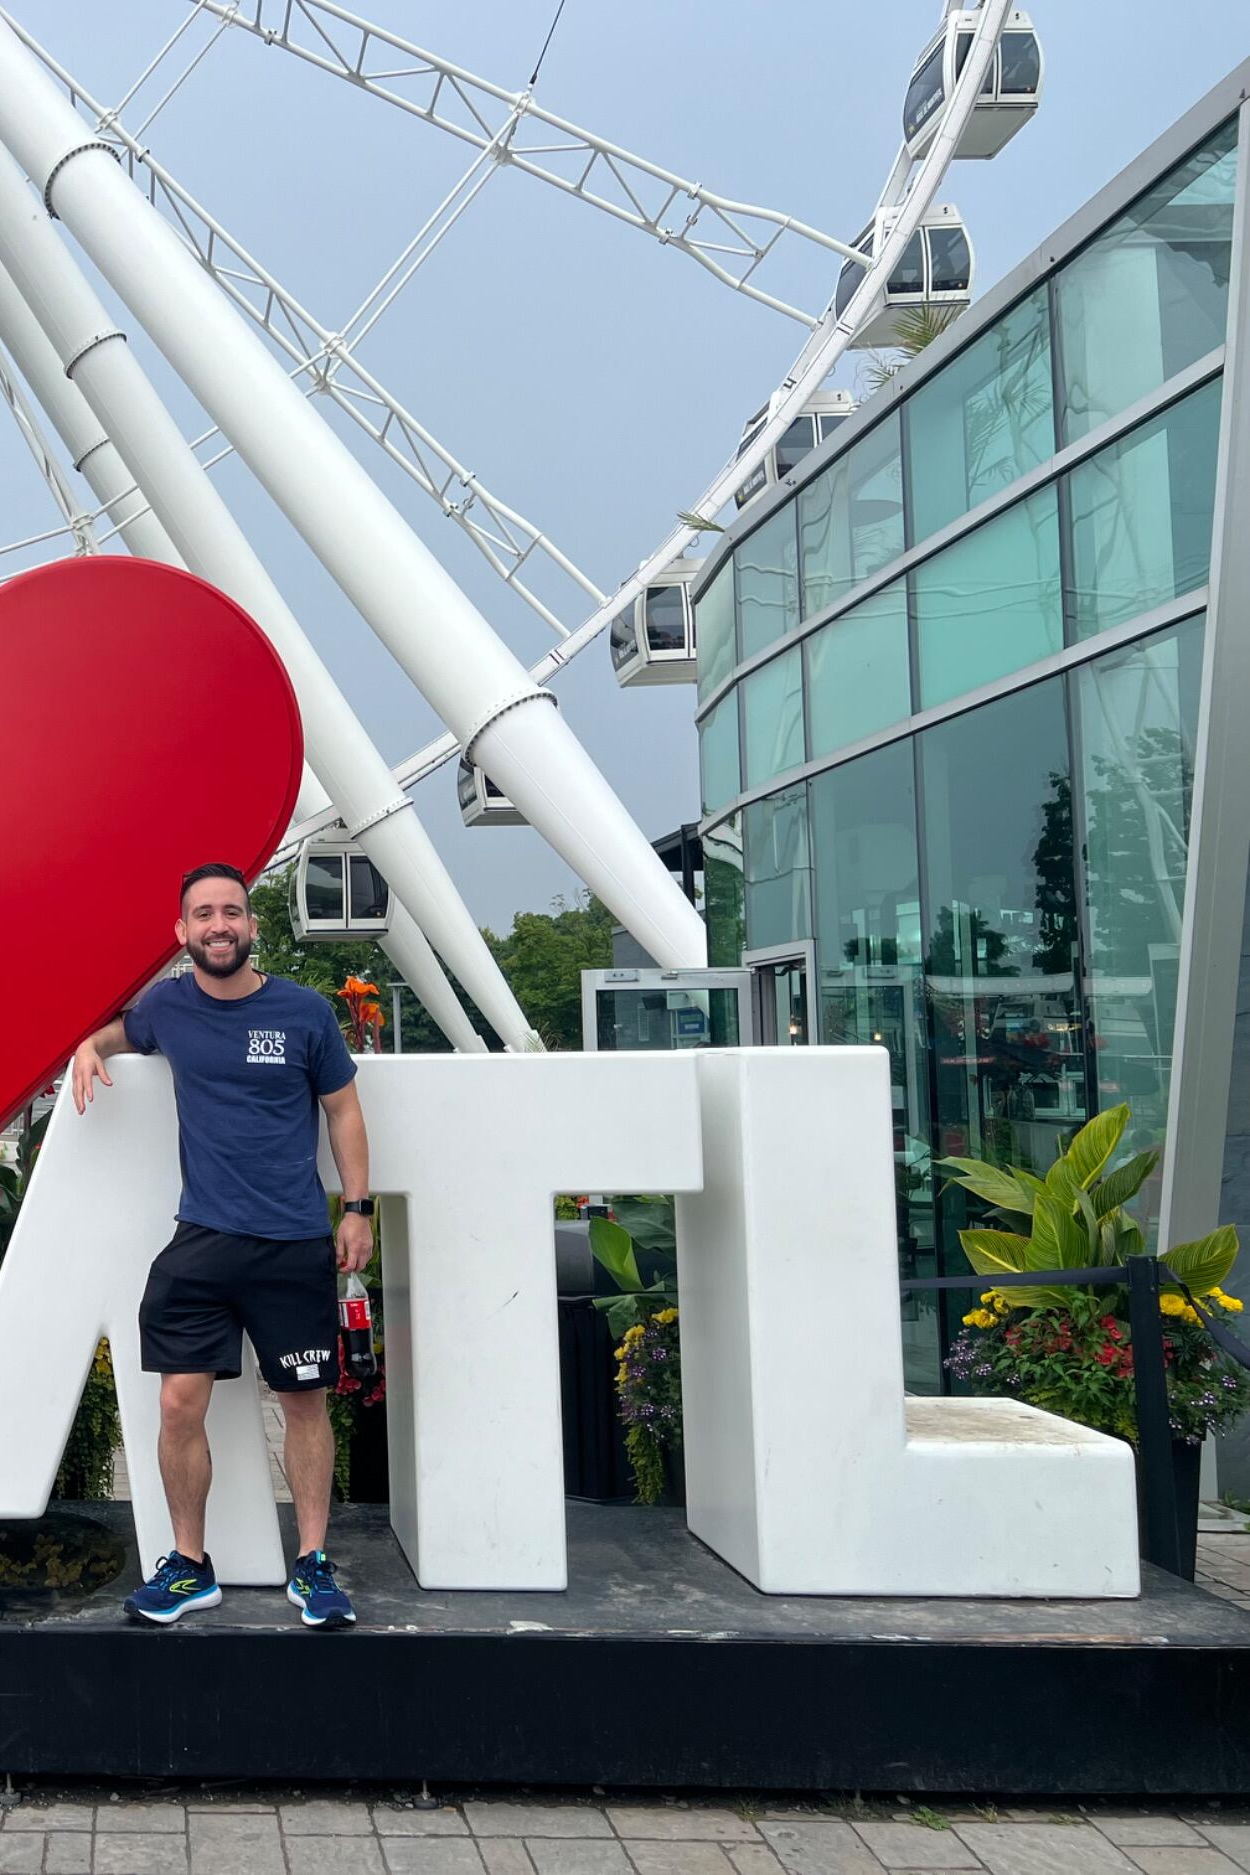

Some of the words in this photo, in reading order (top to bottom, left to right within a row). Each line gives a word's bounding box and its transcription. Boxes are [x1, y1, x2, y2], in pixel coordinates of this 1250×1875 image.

[248, 1030, 286, 1040] VENTURA
[249, 1039, 285, 1056] 805
[246, 1055, 286, 1065] CALIFORNIA
[279, 1352, 303, 1369] KILL
[303, 1349, 331, 1364] CREW
